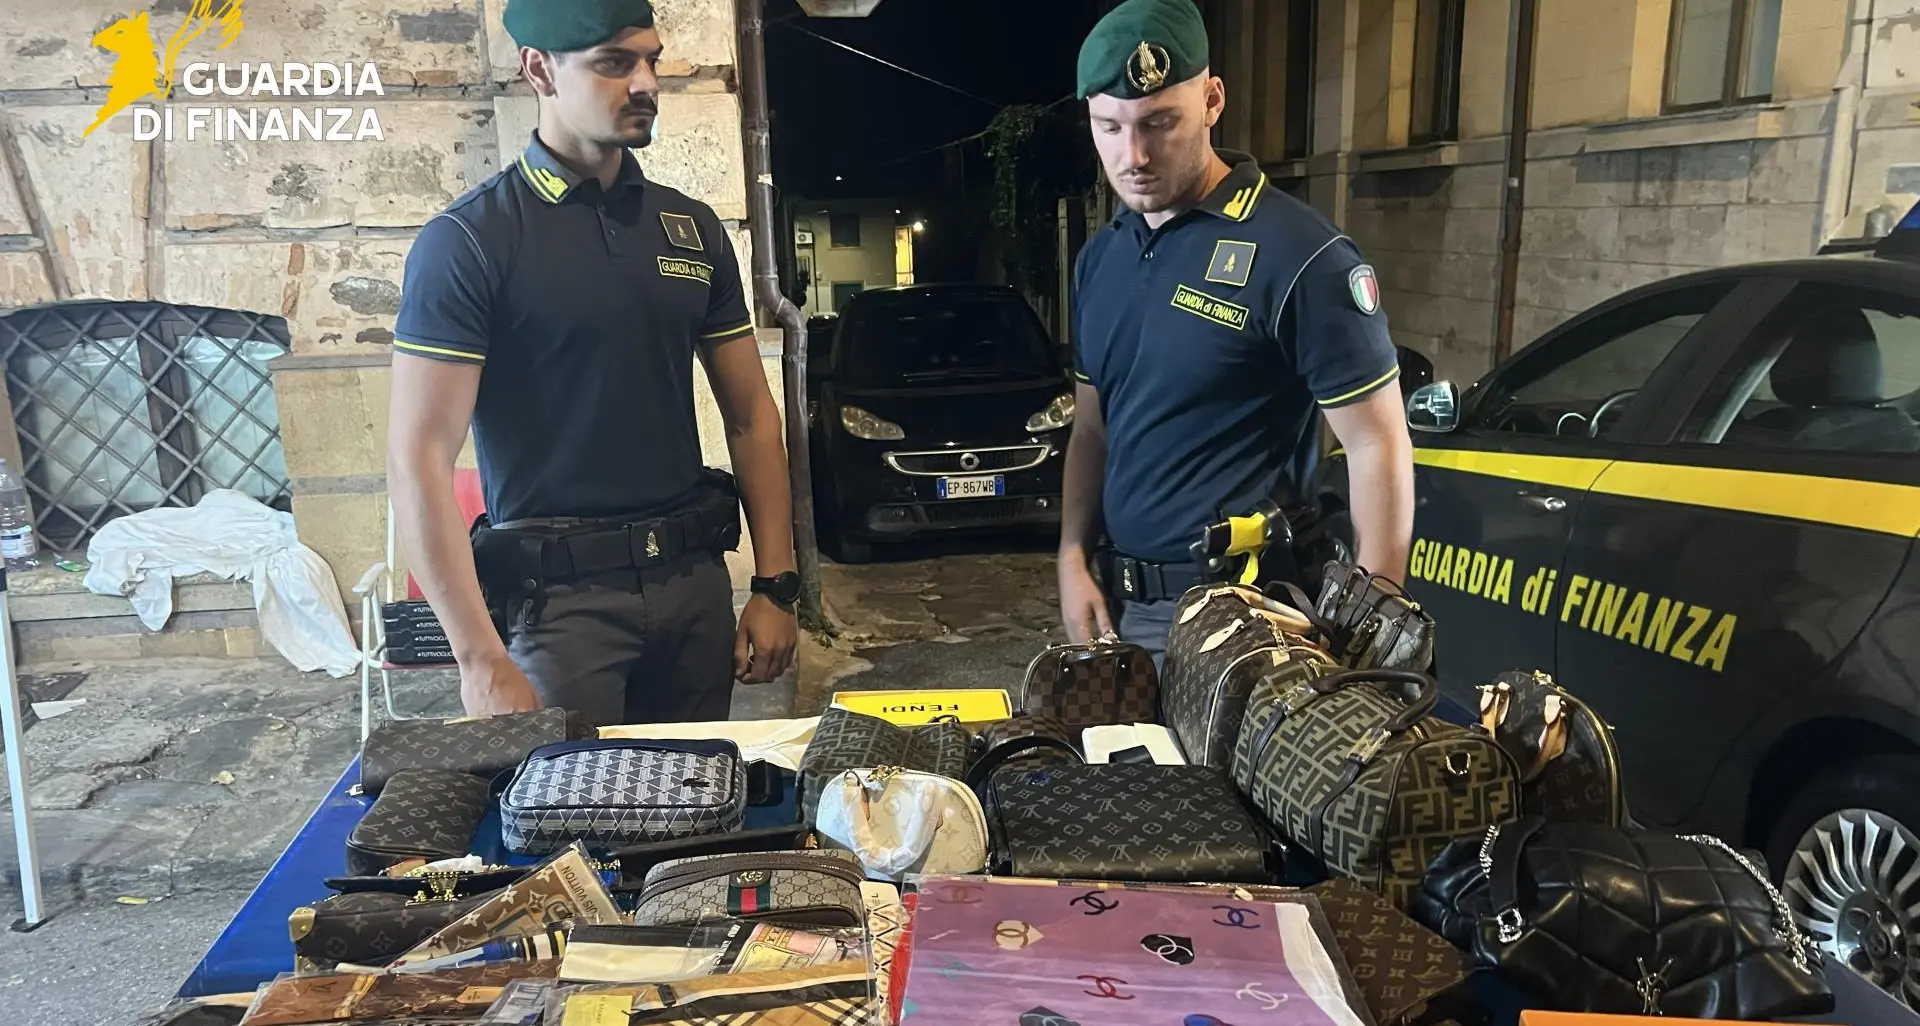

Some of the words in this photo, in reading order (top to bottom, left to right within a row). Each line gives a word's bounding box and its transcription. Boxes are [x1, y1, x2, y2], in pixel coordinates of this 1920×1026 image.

[662, 261, 690, 275] GUARDIA
[1176, 291, 1205, 311] GUARDIA
[1203, 302, 1212, 314] di
[1211, 303, 1243, 324] FINANZA
[947, 482, 960, 495] EP
[1410, 538, 1514, 605] GUARDIA
[1521, 567, 1557, 616] di
[1560, 575, 1737, 673] FINANZA
[883, 704, 958, 713] FENDI
[561, 865, 588, 902] VUITTON
